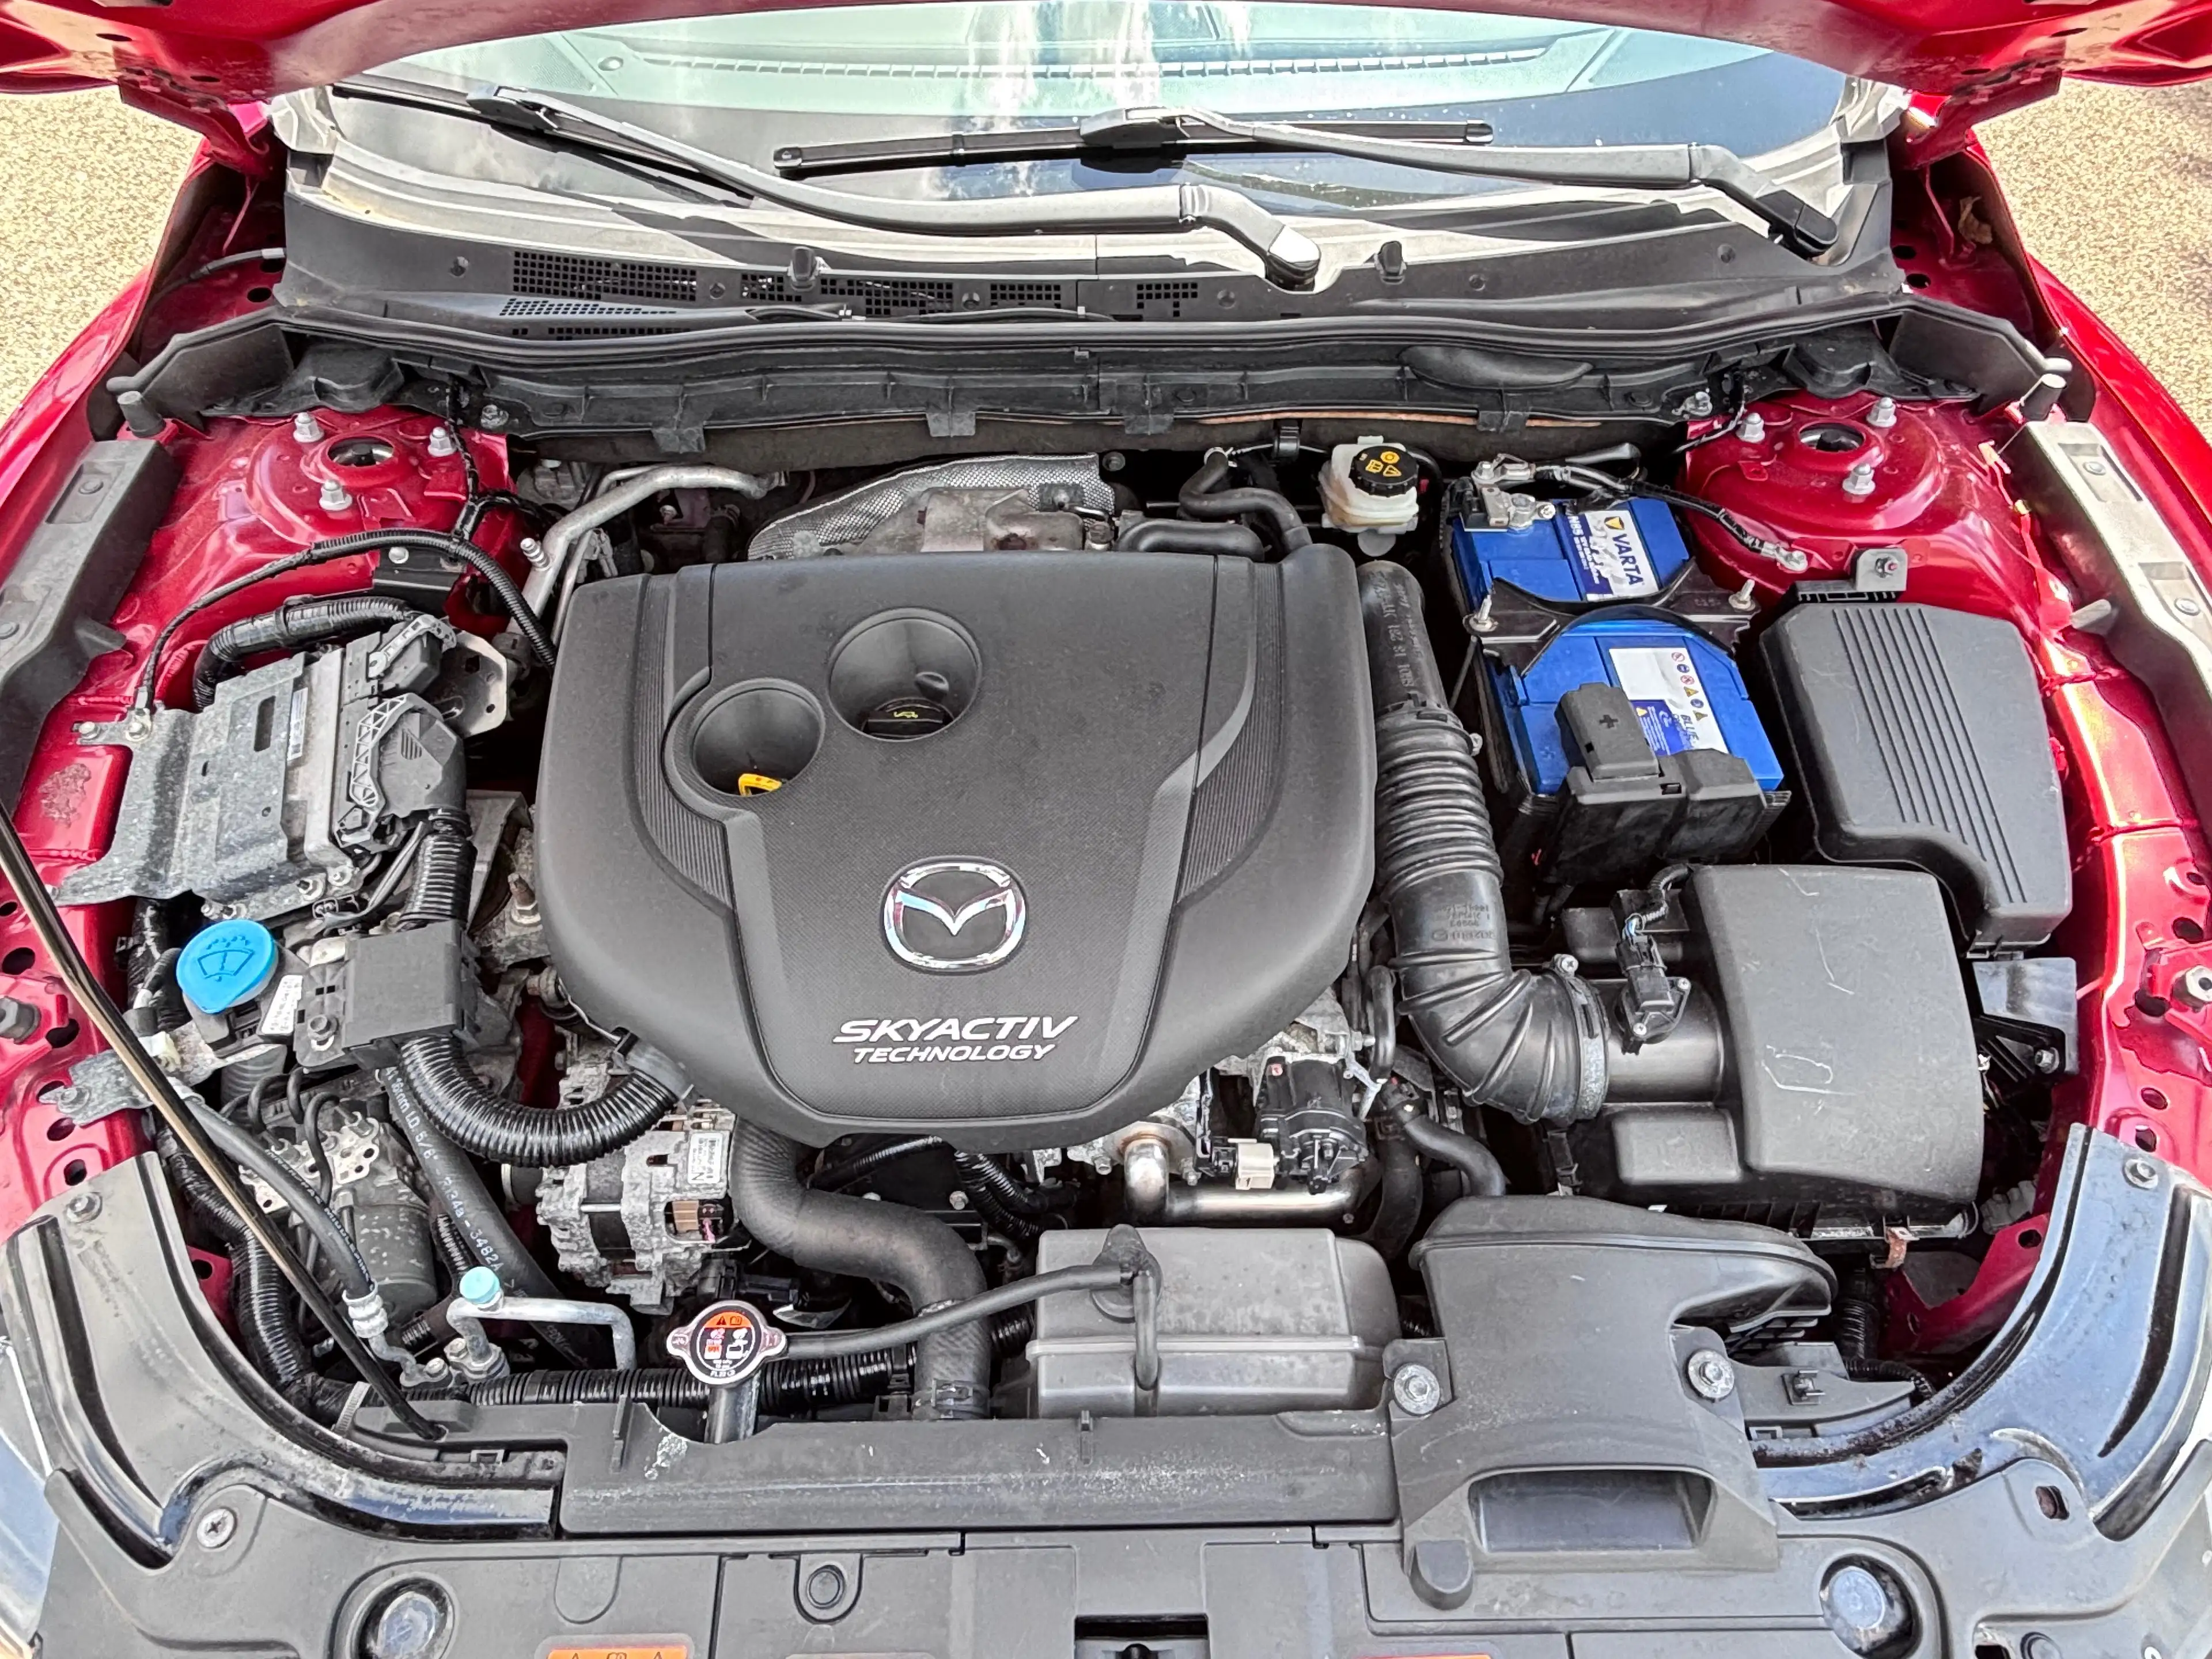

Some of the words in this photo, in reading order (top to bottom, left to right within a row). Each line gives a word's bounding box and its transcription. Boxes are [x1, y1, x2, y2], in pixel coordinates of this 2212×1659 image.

[1612, 533, 1643, 585] VARTA
[832, 1016, 1079, 1043] SKYACTIV
[854, 1044, 1055, 1064] TECHNOLOGY
